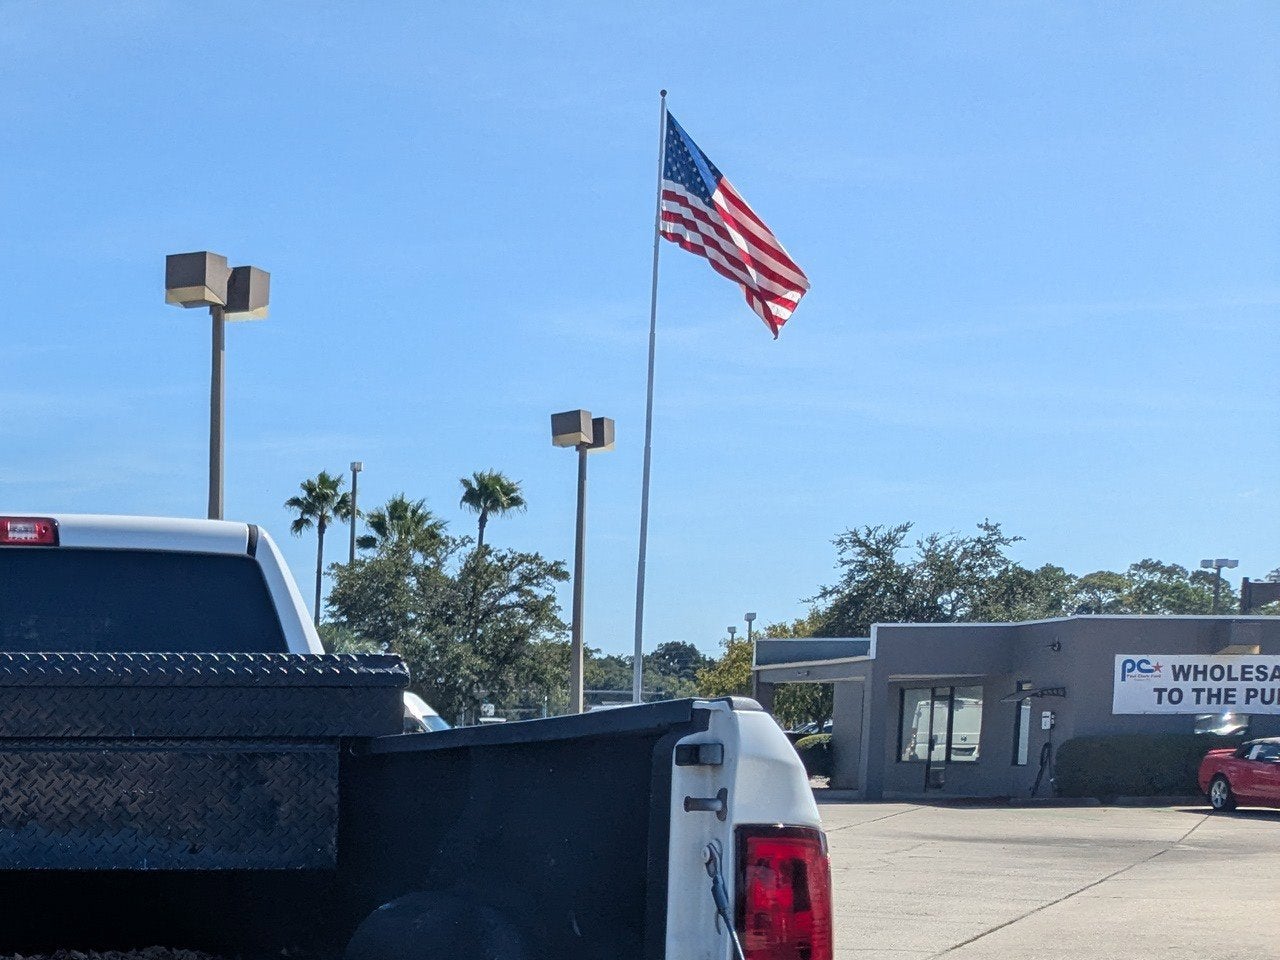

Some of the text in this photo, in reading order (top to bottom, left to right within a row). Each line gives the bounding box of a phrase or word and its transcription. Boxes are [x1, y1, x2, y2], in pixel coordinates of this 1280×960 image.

[1153, 687, 1280, 705] TO THE PU
